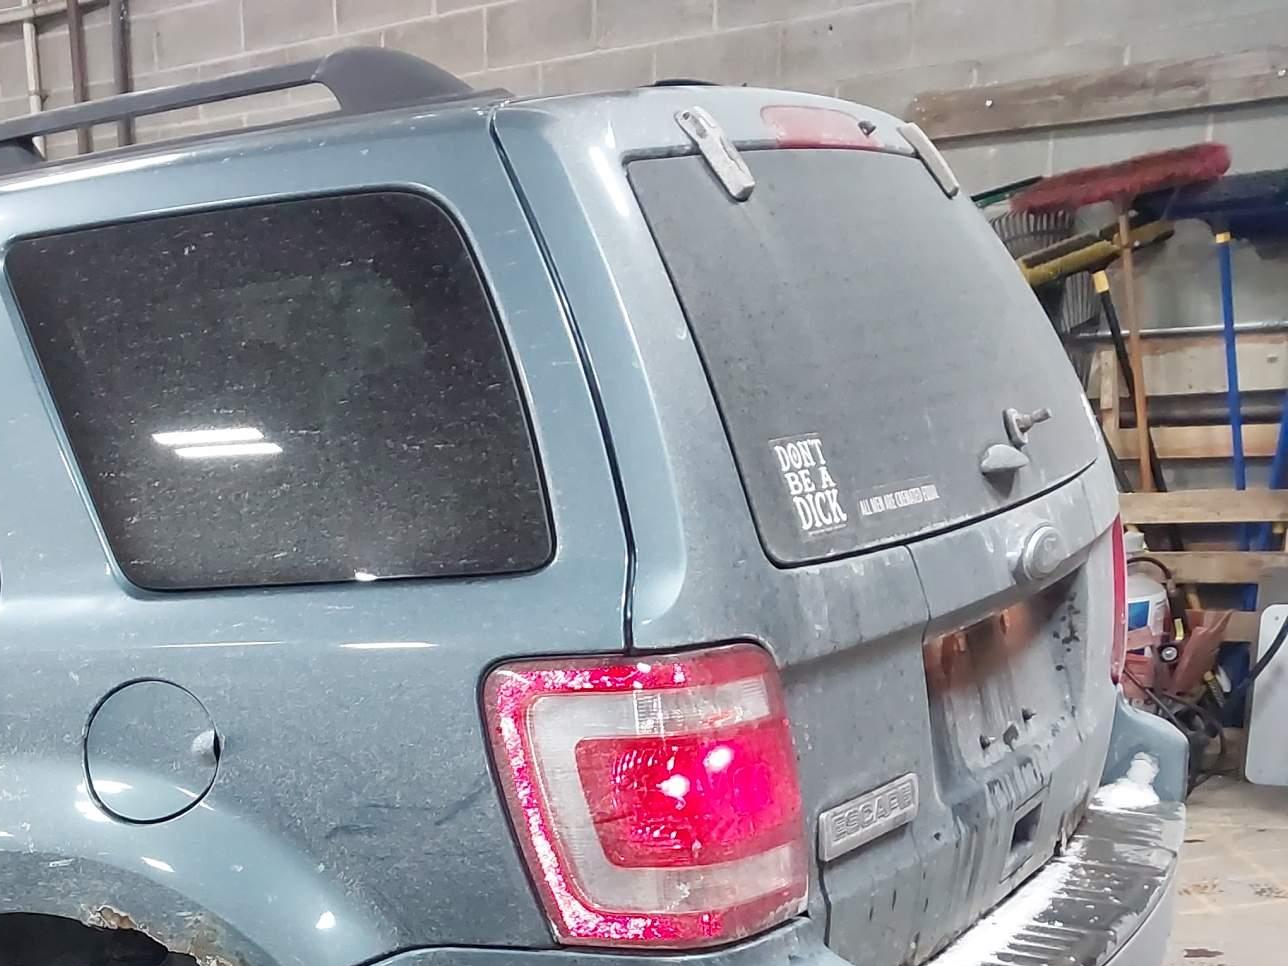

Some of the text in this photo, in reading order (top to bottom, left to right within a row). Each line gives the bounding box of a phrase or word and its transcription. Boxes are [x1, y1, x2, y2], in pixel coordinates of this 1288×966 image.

[774, 438, 826, 472] DON'T
[784, 466, 837, 496] BE A
[792, 488, 848, 531] DICK
[831, 781, 914, 843] ESCAPE
